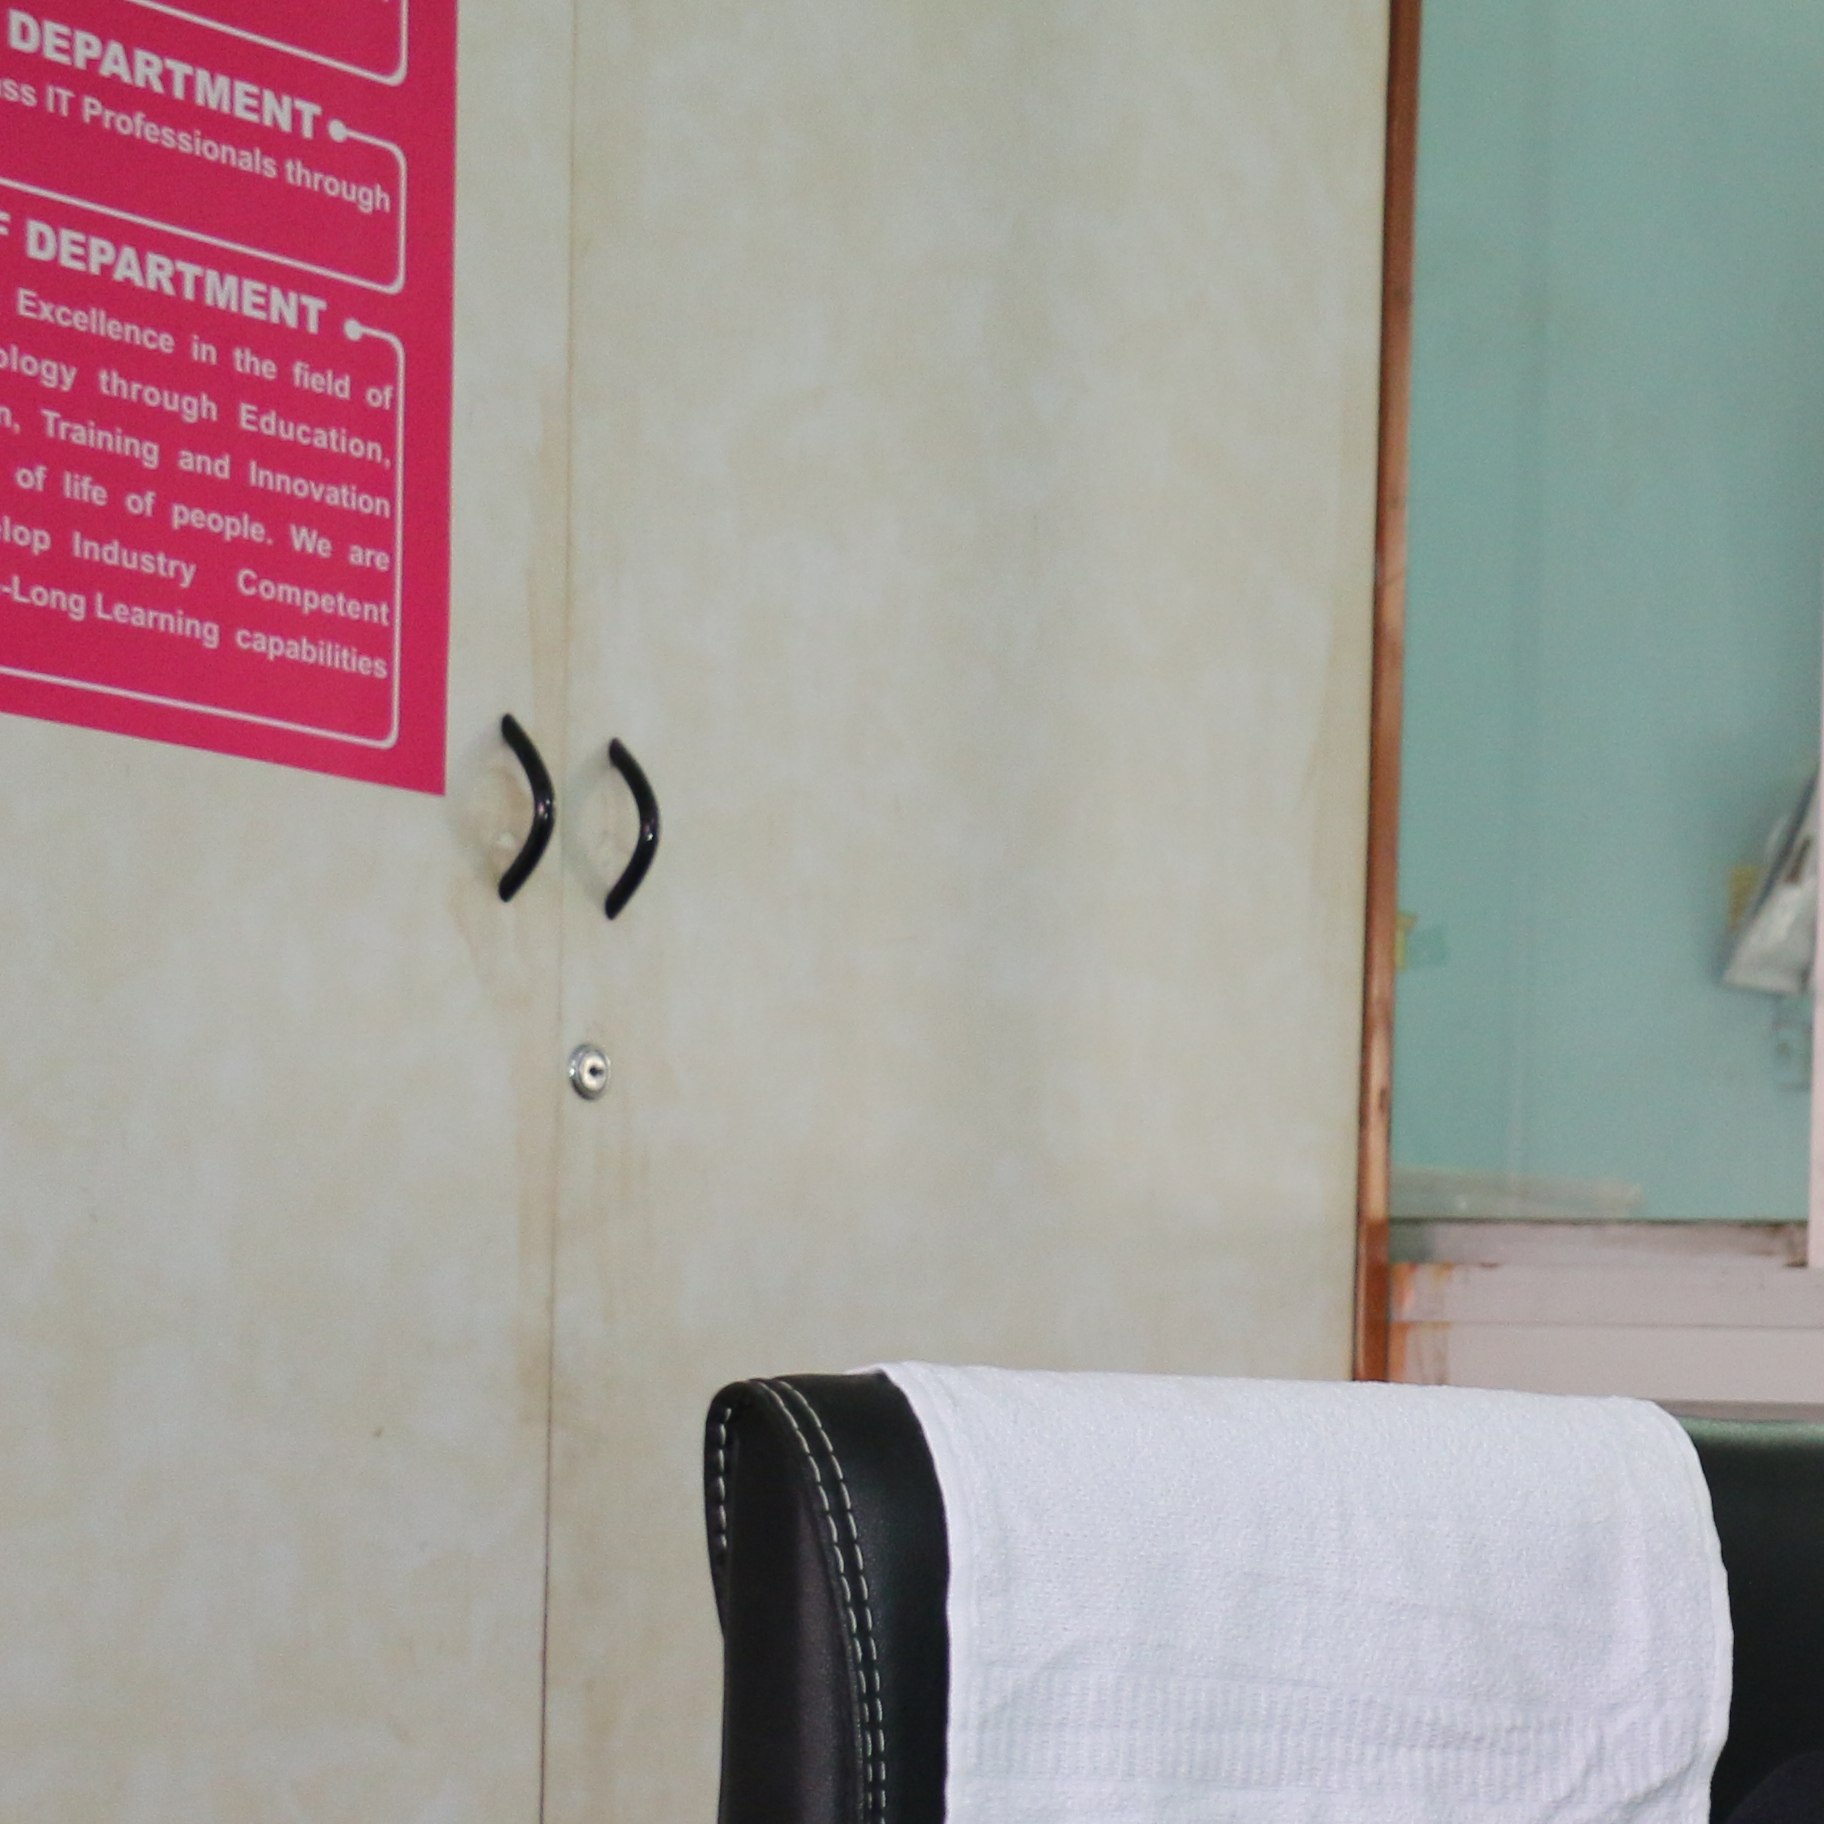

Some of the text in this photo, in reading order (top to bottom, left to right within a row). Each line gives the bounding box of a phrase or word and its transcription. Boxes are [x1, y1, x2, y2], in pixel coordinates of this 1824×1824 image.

[8, 8, 323, 140] DEPARTMENT
[0, 78, 391, 215] ss IT Professionals through
[25, 218, 327, 335] DEPARTMENT
[16, 287, 393, 411] Excellence in the field of
[40, 408, 160, 469] Training
[178, 448, 230, 480] and
[249, 461, 390, 518] Innovation
[98, 369, 218, 424] through
[238, 403, 391, 469] Education,
[0, 515, 391, 626] lop Industry Competent
[15, 465, 390, 572] of life of people. We are
[95, 591, 220, 649] Learning
[236, 625, 388, 680] capabilities
